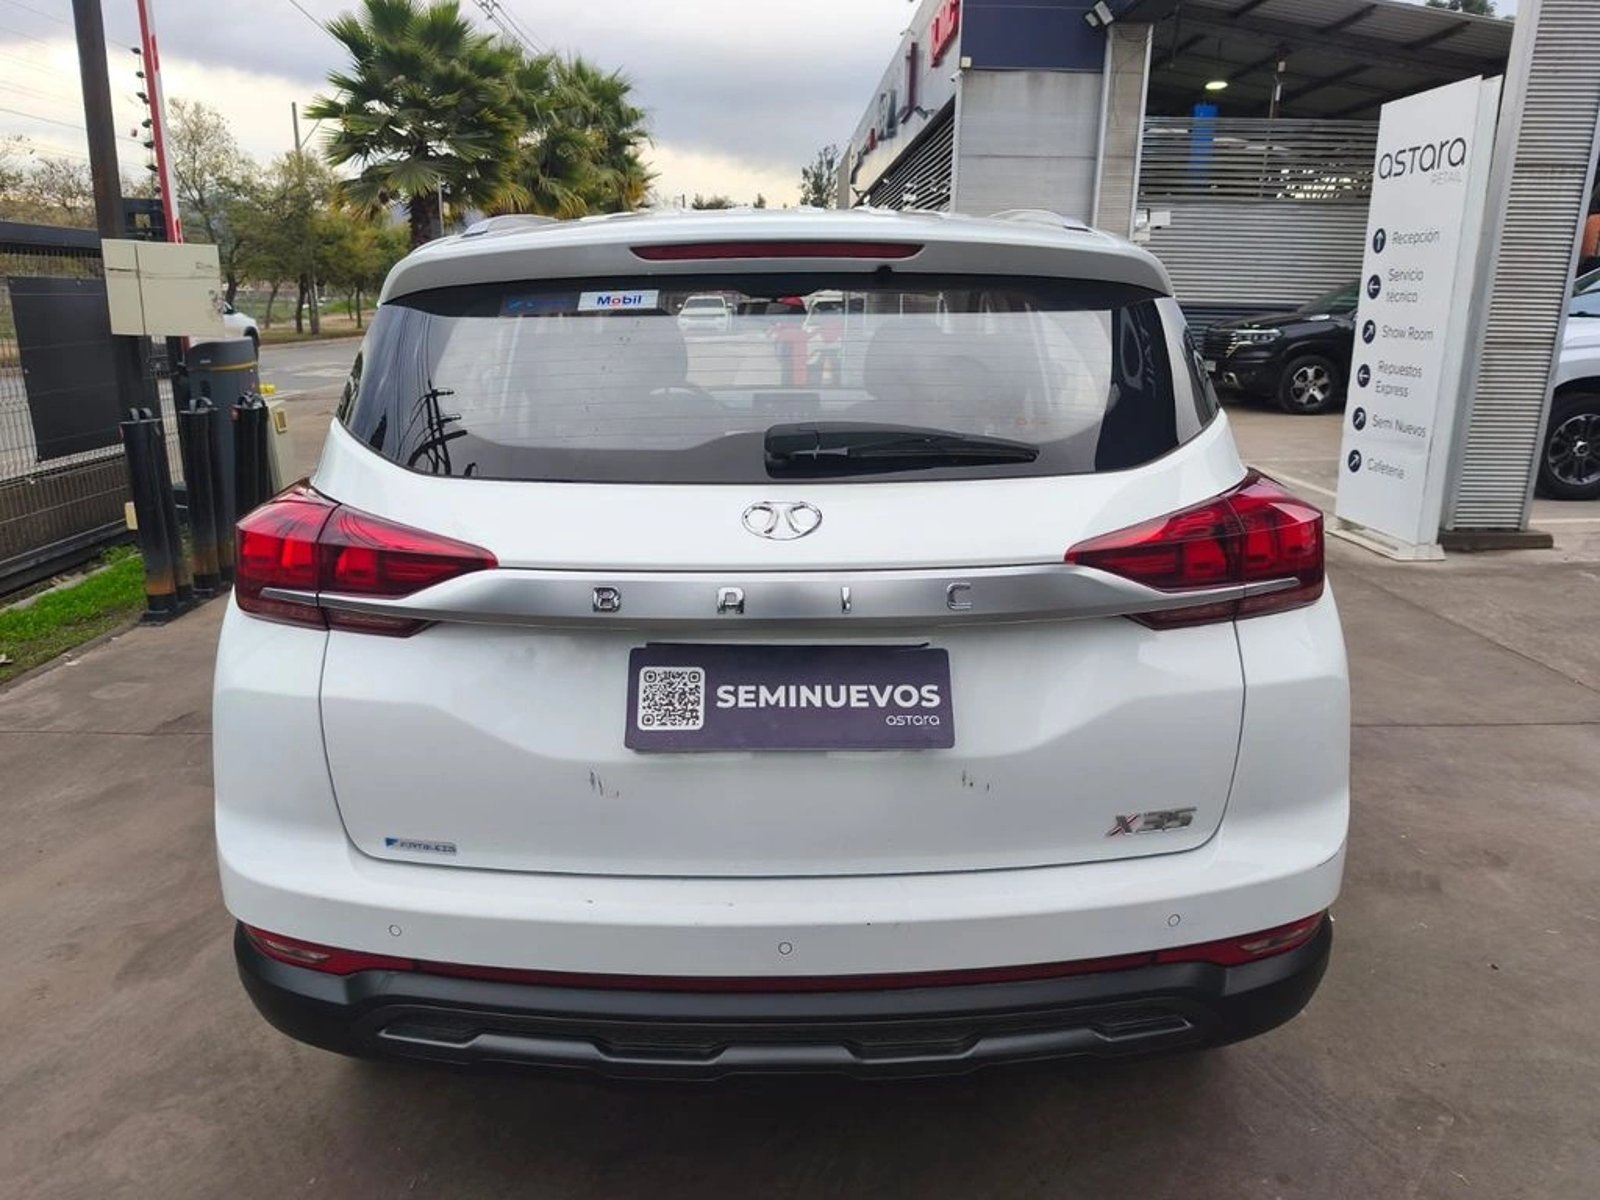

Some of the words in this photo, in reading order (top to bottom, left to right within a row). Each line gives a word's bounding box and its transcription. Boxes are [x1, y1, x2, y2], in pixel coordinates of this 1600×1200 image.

[1378, 137, 1467, 179] astara
[1391, 228, 1440, 246] Recepción
[1388, 268, 1424, 281] Servicio
[597, 294, 642, 306] Mobil
[1381, 324, 1406, 339] Show
[1408, 326, 1433, 340] Room
[1378, 360, 1422, 379] Repuestos
[1375, 381, 1409, 398] Express
[1372, 414, 1393, 428] Semi
[1395, 419, 1426, 438] Nuevos
[592, 582, 972, 613] BAIC
[716, 684, 940, 708] SEMINUEVOS
[885, 714, 940, 726] astara
[1106, 807, 1197, 837] X35
